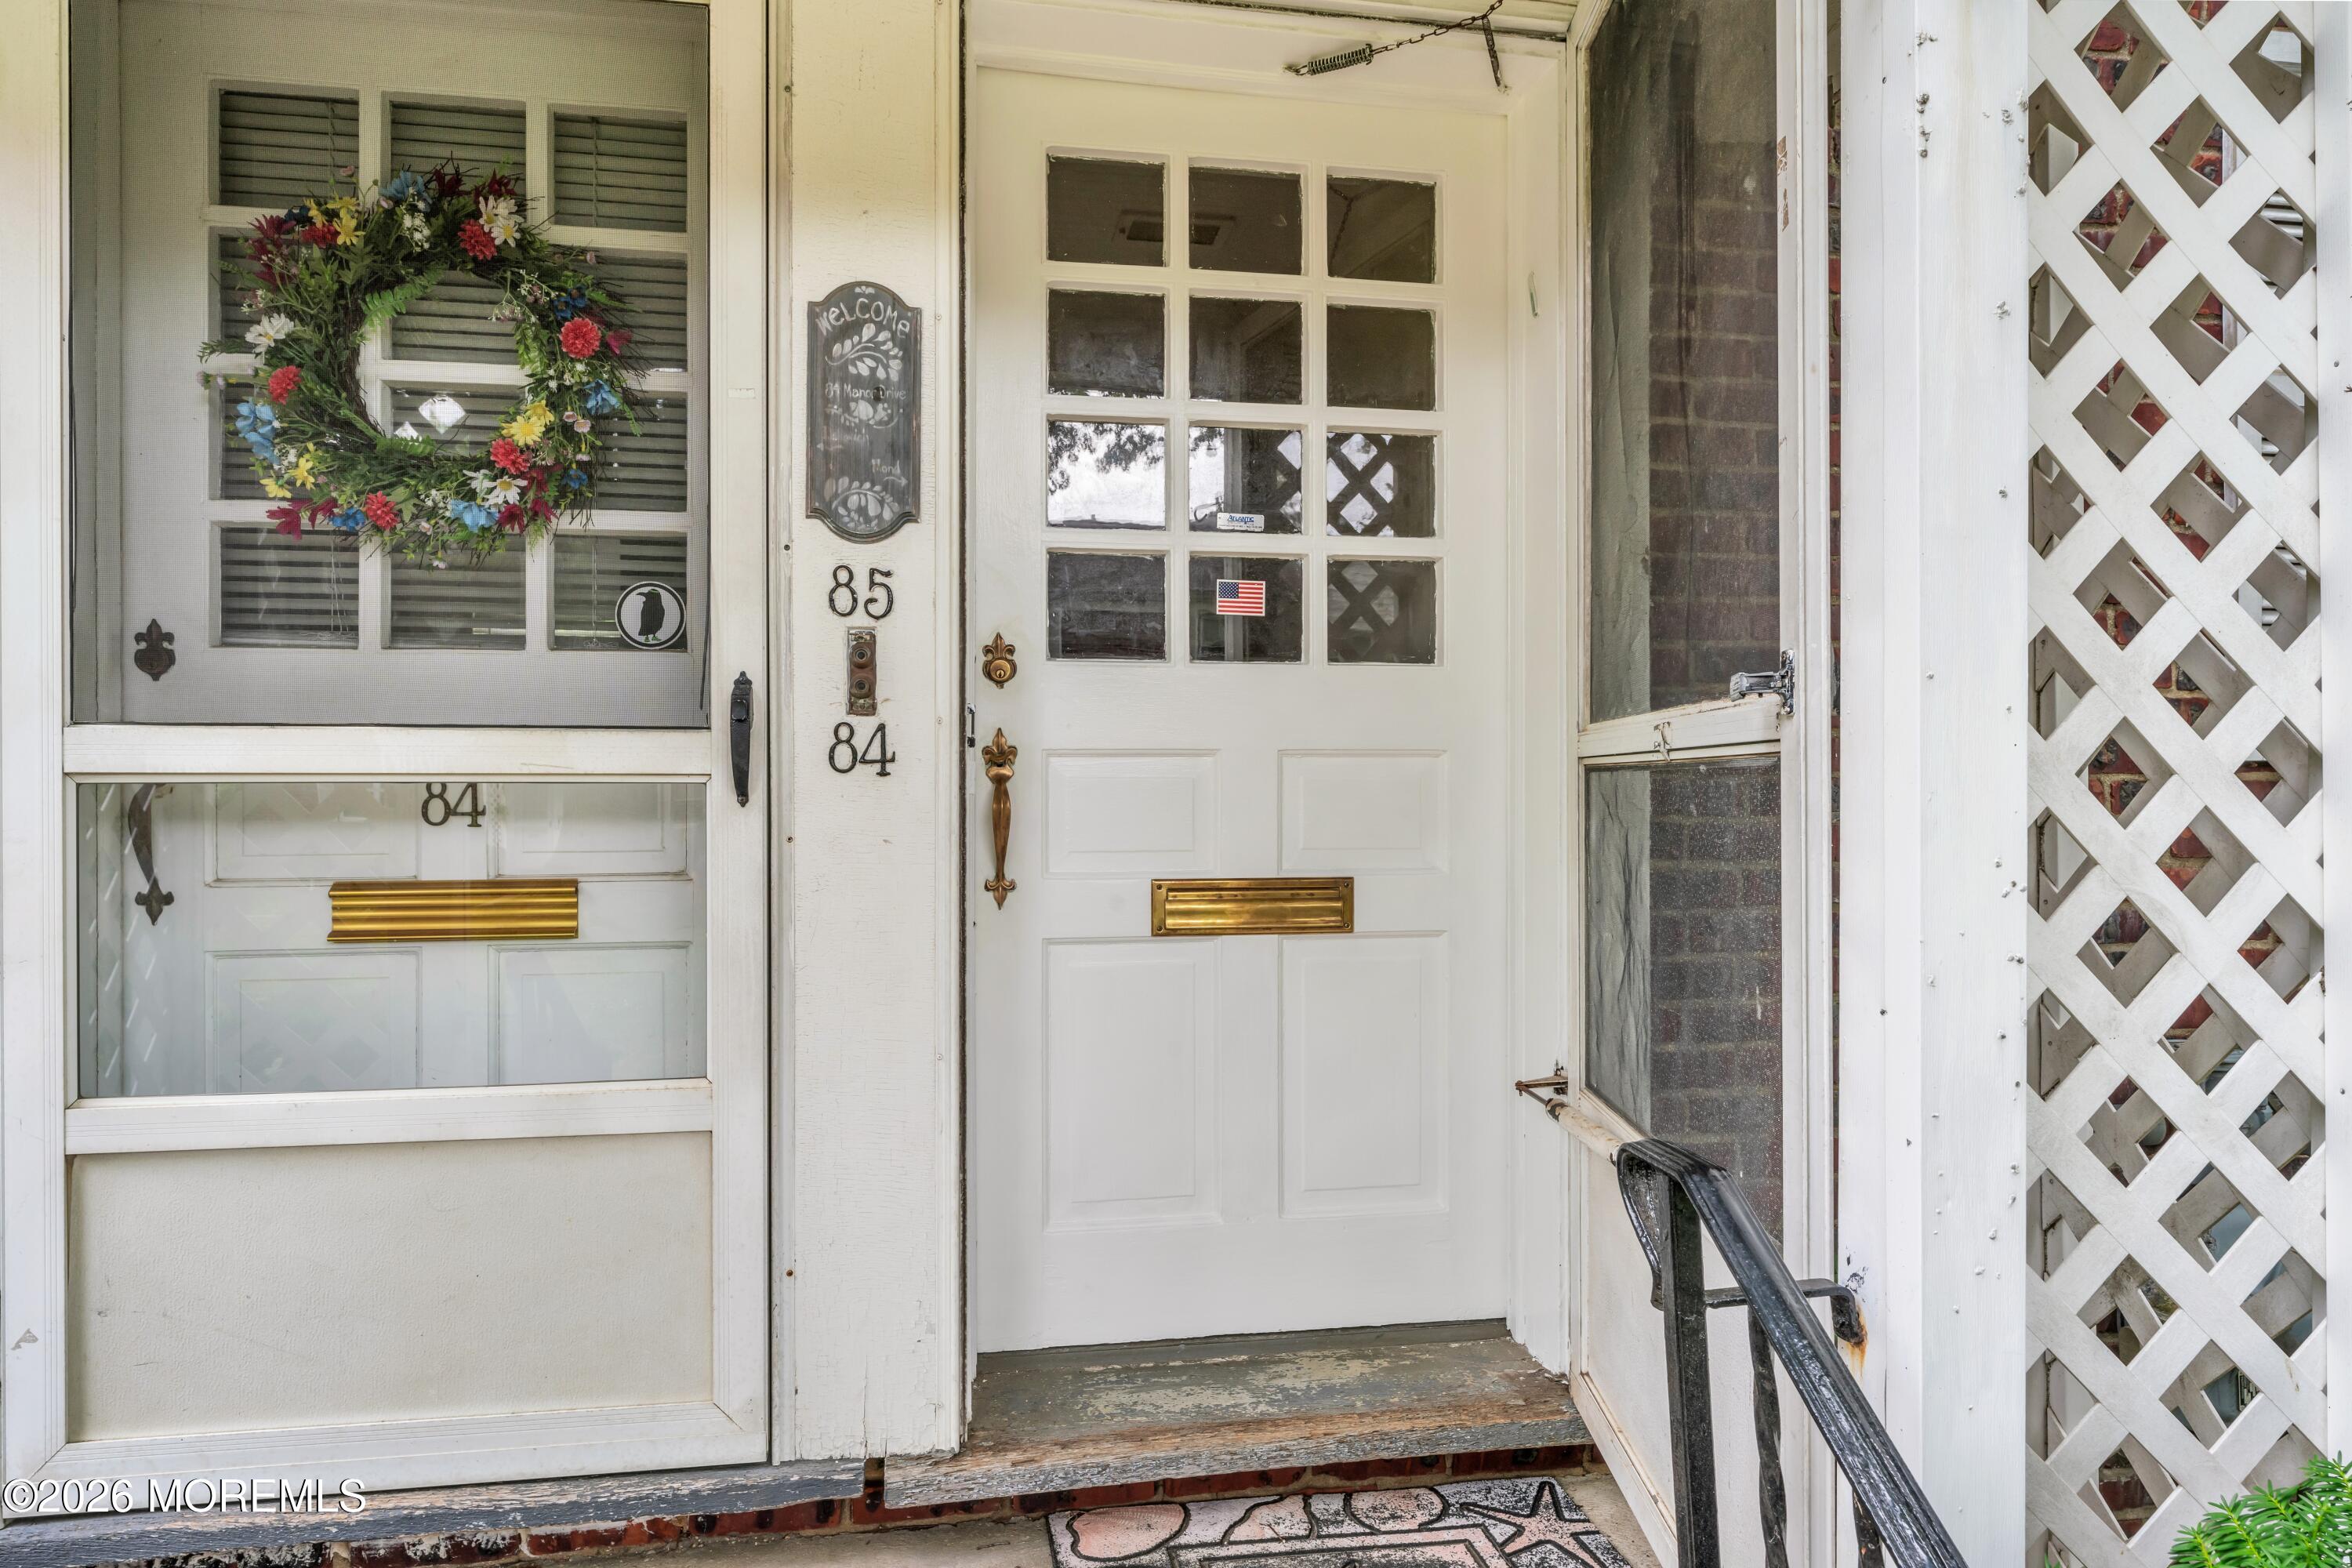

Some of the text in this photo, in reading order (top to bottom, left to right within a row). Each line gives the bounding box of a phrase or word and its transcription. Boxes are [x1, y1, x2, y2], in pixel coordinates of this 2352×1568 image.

[844, 383, 877, 398] Manor
[879, 384, 906, 399] Drive
[829, 565, 893, 619] 85
[829, 722, 895, 776] 84
[422, 782, 486, 827] 84
